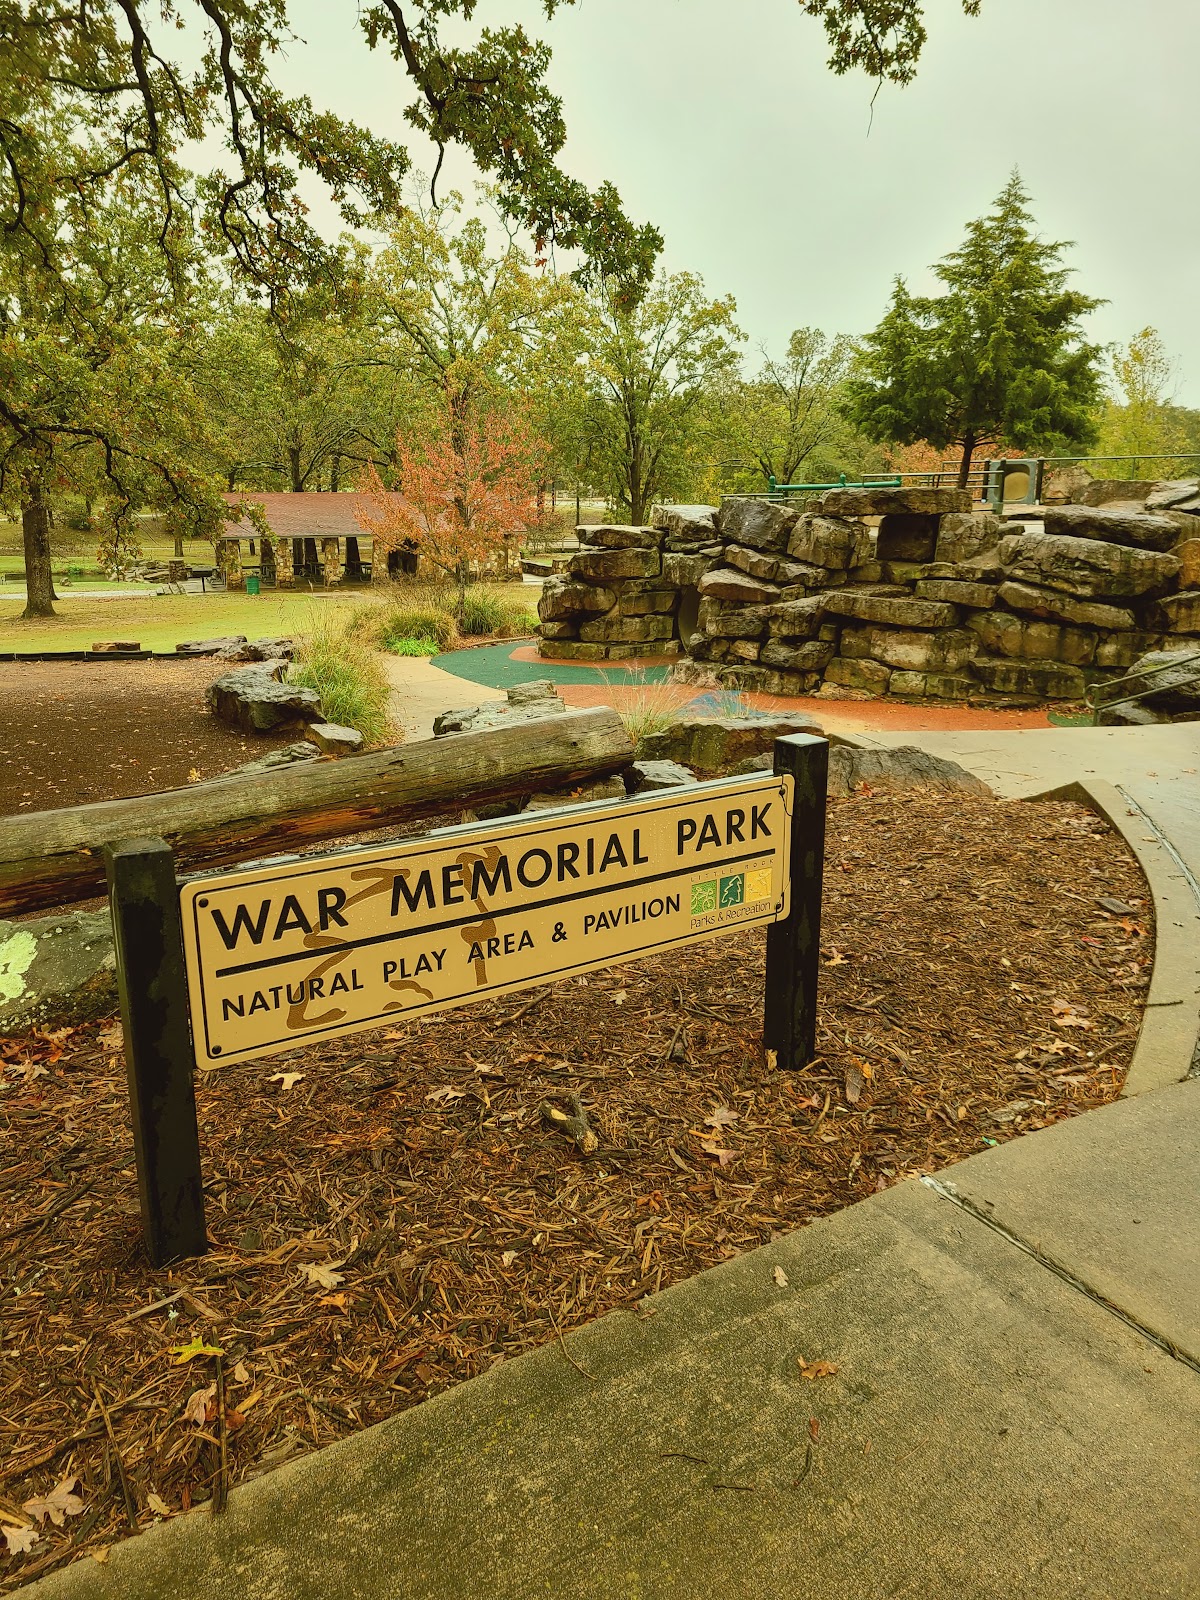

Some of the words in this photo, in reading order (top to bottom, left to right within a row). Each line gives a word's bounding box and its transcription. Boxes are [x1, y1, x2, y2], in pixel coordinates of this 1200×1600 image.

[210, 886, 349, 952] WAR
[390, 828, 649, 917] MEMORIAL
[677, 802, 773, 856] PARK
[690, 914, 715, 929] Parks
[718, 911, 724, 922] &
[726, 901, 771, 920] Recreation
[222, 967, 364, 1022] NATURAL
[383, 948, 448, 984] PLAY
[467, 929, 535, 962] AREA
[551, 921, 568, 943] &
[584, 893, 681, 935] PAVILION
